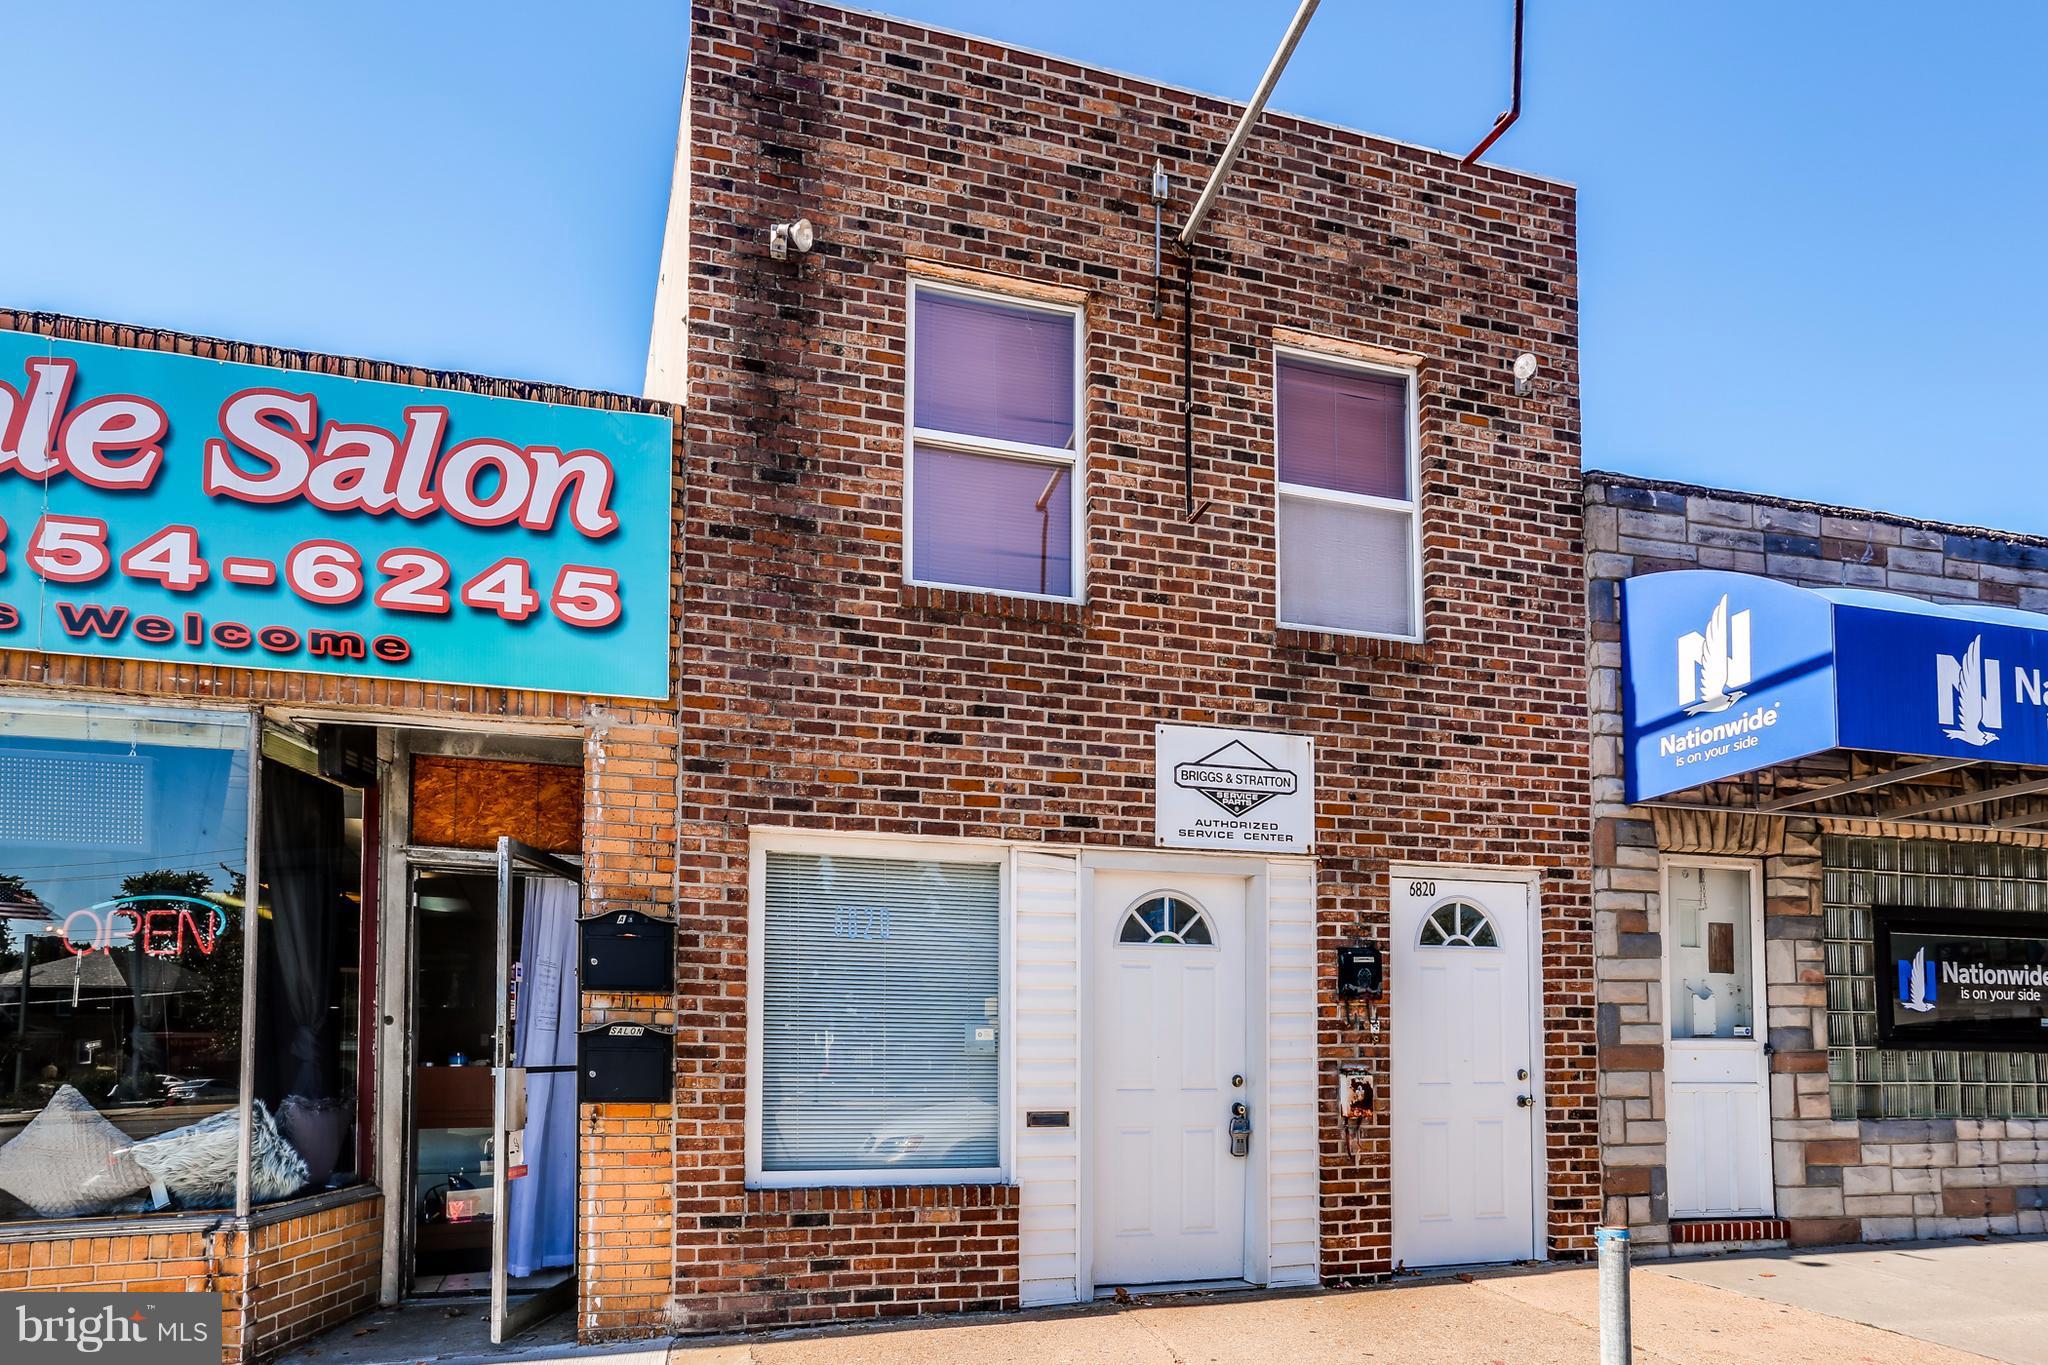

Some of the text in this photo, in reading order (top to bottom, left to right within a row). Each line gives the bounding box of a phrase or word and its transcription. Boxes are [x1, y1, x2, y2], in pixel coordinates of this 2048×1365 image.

[0, 360, 617, 536] le Salon
[0, 514, 621, 627] 54-6245
[57, 603, 410, 660] Welcome
[2014, 666, 2048, 706] N
[1660, 707, 1778, 757] Nationwide
[1675, 735, 1759, 767] is on your side
[1181, 770, 1291, 788] BRIGGS & STRATTON
[1216, 791, 1259, 801] SERVICE
[1178, 829, 1294, 842] SERVICE CENTER
[1195, 819, 1279, 831] AUTHORIZED
[1409, 881, 1436, 897] 6820
[62, 908, 216, 956] OPEN
[1960, 987, 2041, 1002] is on your side
[610, 1027, 643, 1036] SALON
